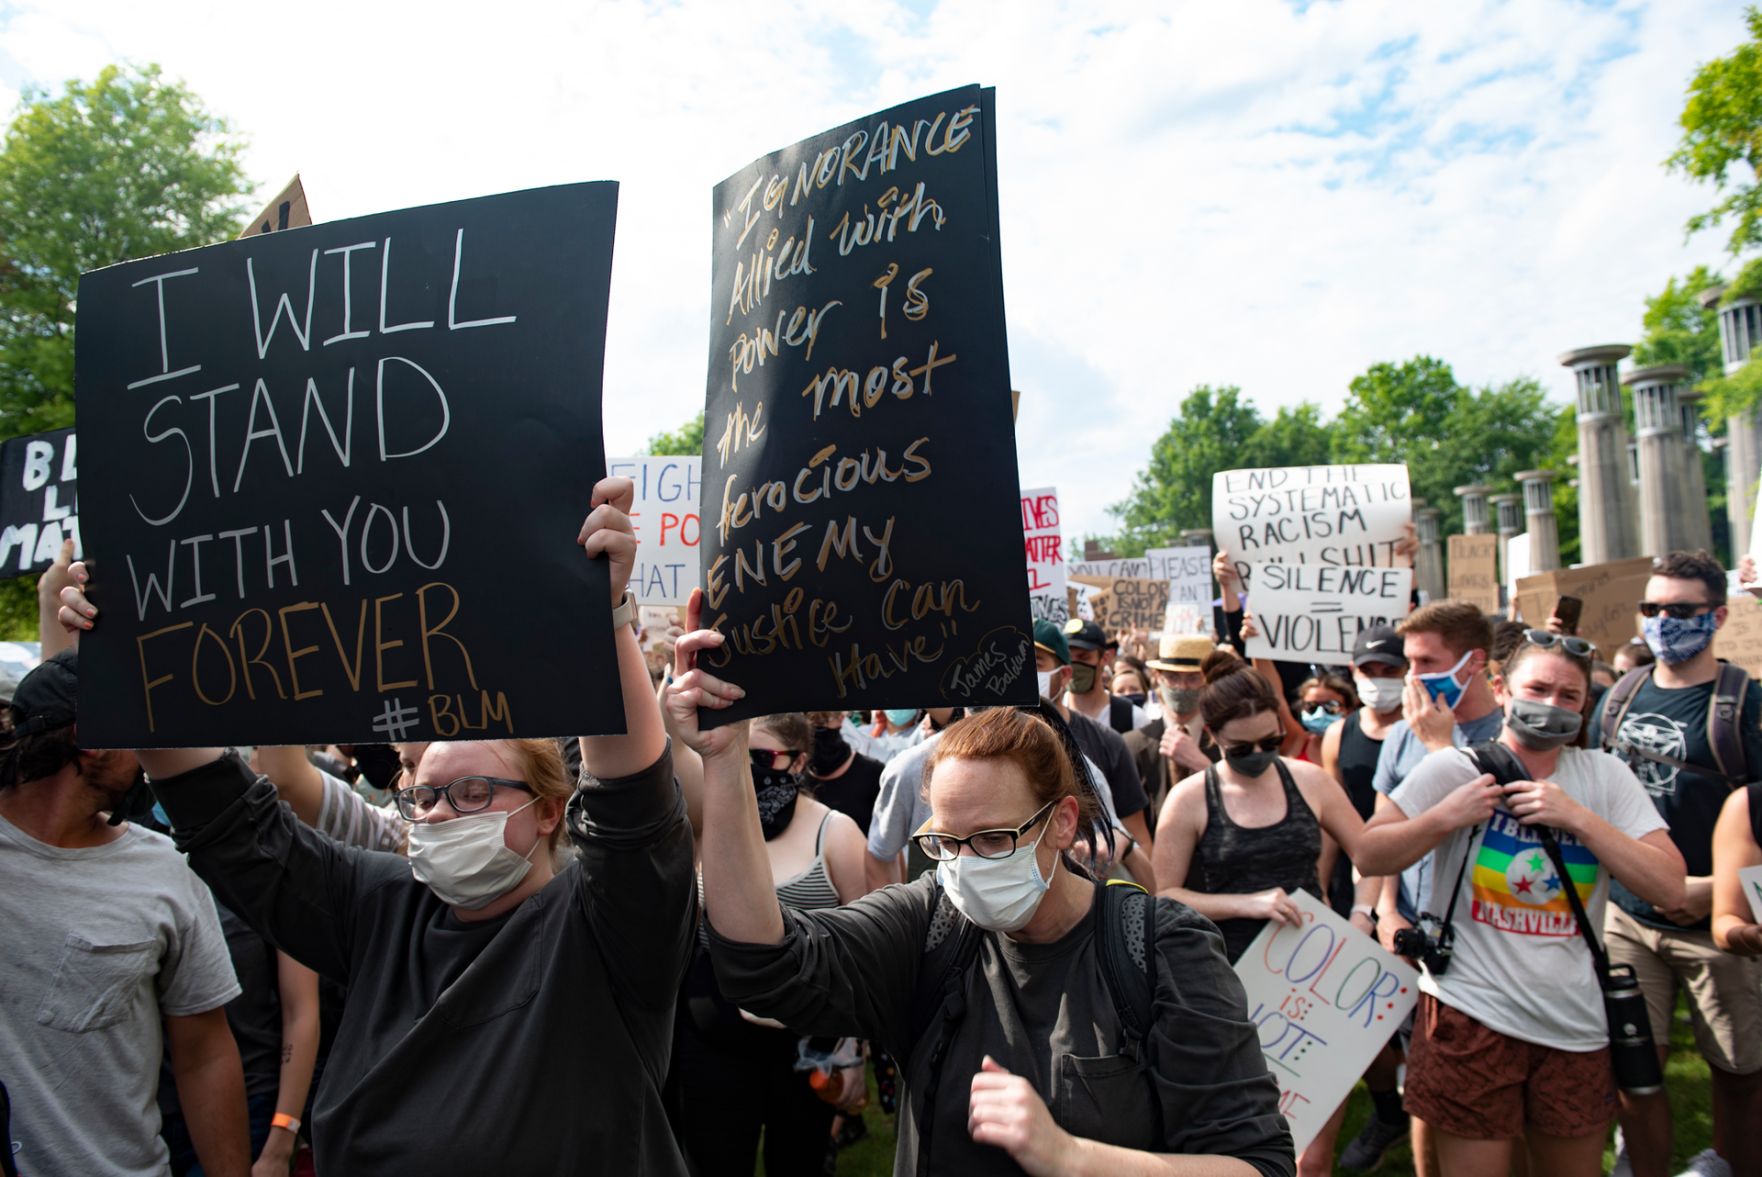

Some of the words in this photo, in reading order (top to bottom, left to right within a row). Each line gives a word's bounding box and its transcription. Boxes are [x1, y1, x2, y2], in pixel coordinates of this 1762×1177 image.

[126, 266, 202, 390] I
[246, 227, 518, 360] WILL
[129, 355, 451, 526] STAND
[610, 463, 702, 503] FIGH
[1226, 468, 1289, 493] END
[1300, 466, 1374, 484] THE
[1020, 494, 1060, 532] IVES
[1228, 481, 1407, 521] SYSTEMATIC
[1239, 508, 1368, 551] RACISM
[126, 518, 299, 622] WITH
[320, 494, 451, 586] YOU
[1025, 535, 1064, 566] ATTER
[1234, 537, 1406, 592] BSHIT
[628, 562, 687, 599] HAT
[1113, 579, 1170, 600] COLOR
[1262, 565, 1401, 598] SILENCE
[1108, 610, 1166, 630] CRIME
[136, 581, 480, 733] FOREVER
[950, 641, 1007, 697] James
[1490, 812, 1504, 832] I
